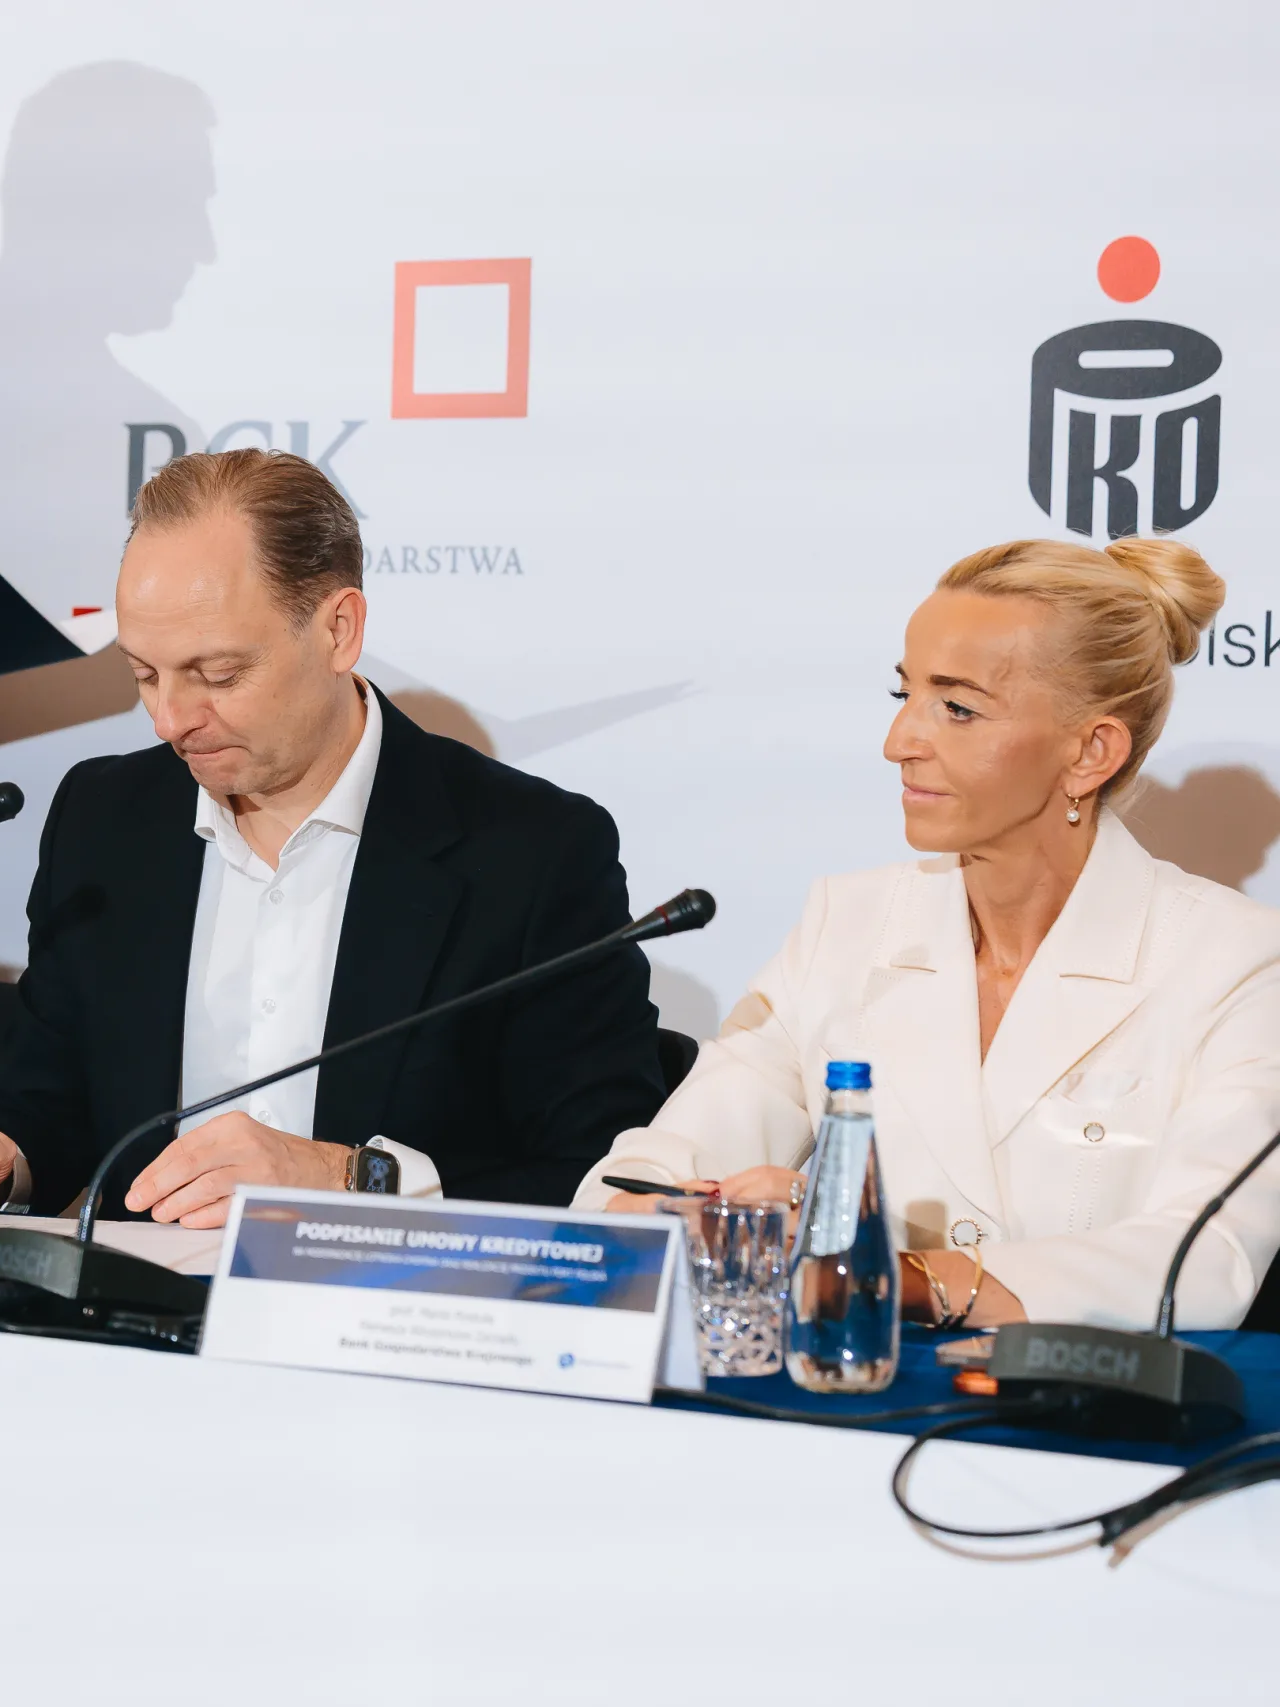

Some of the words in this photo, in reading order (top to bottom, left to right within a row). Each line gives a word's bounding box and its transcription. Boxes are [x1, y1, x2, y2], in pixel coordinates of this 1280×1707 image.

[1028, 319, 1223, 541] PKO
[1184, 608, 1280, 669] lsk
[295, 1221, 406, 1247] PODPISANIE
[406, 1230, 479, 1252] UMOWY
[479, 1235, 604, 1263] KREDYTOWEJ
[1026, 1337, 1141, 1382] BOSCH
